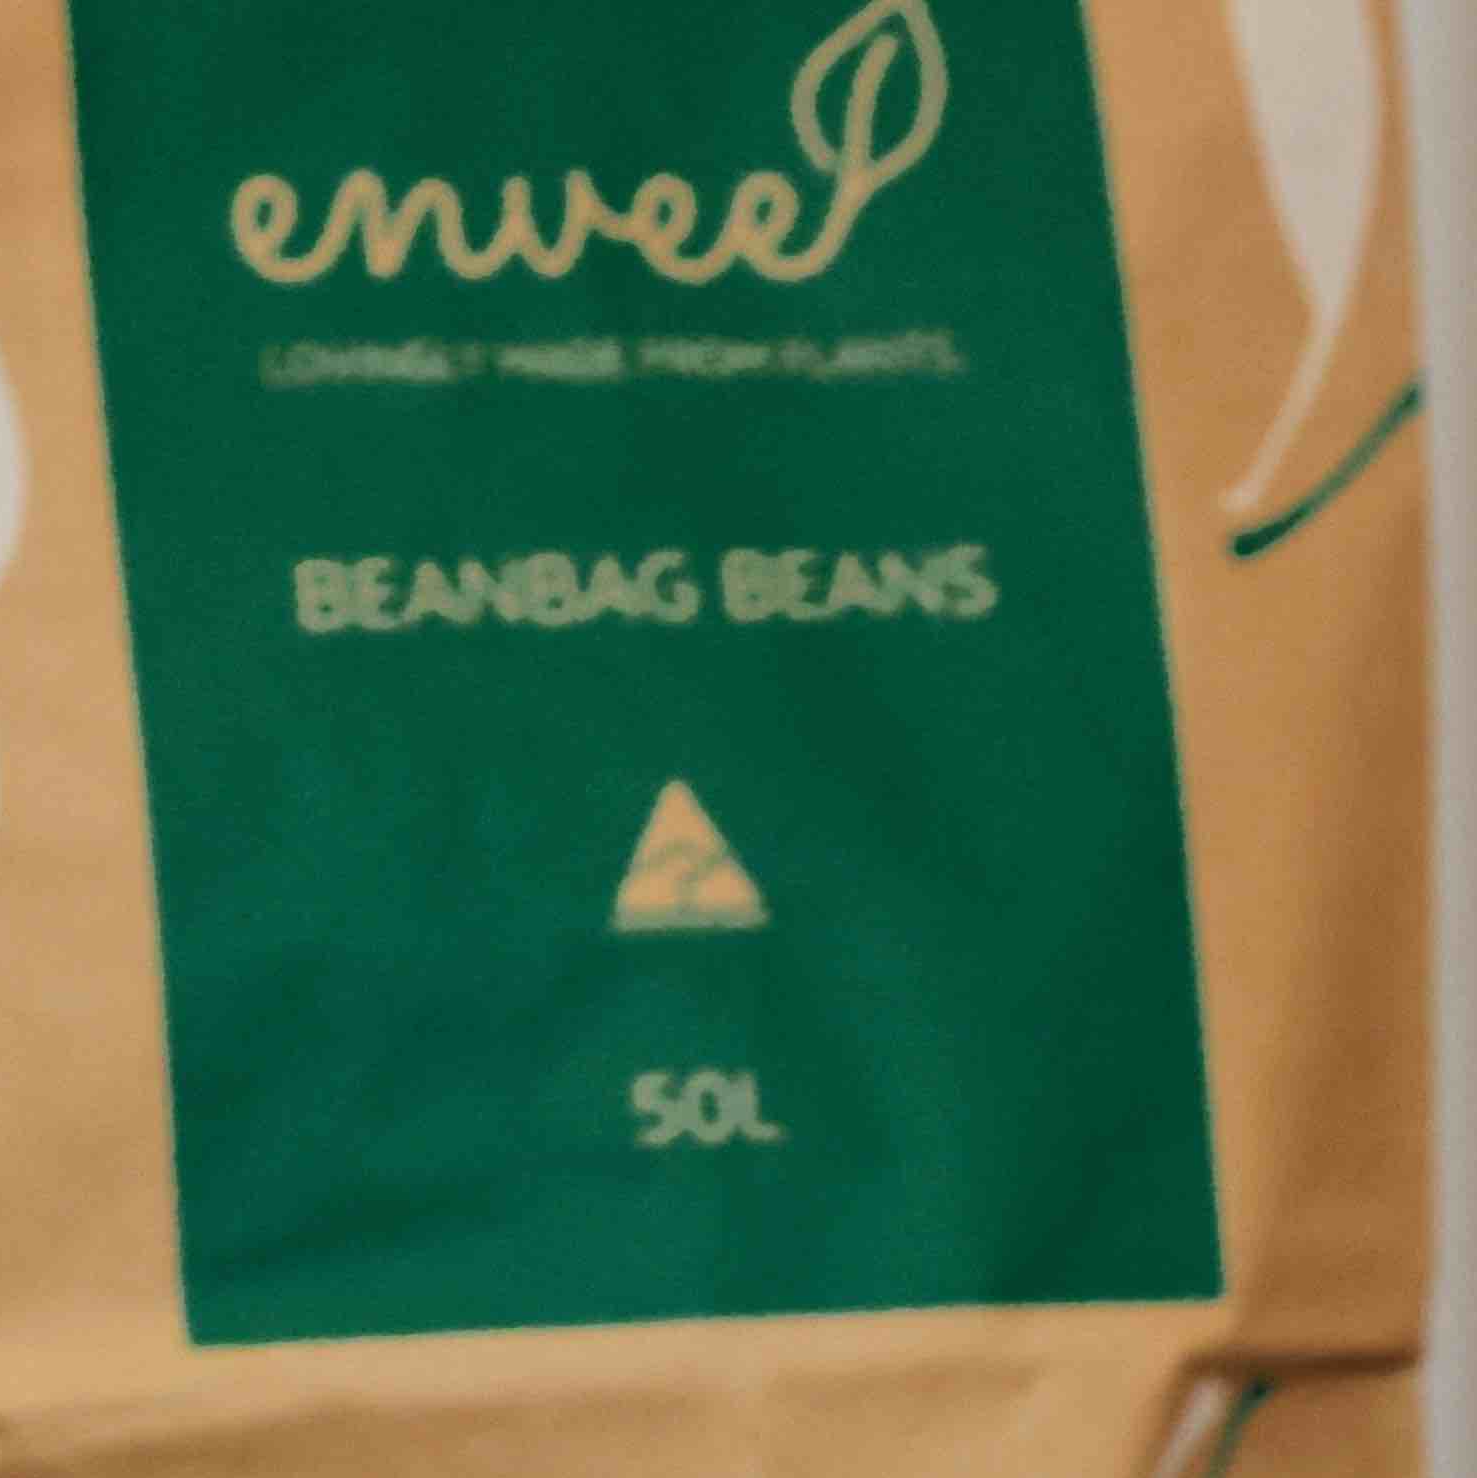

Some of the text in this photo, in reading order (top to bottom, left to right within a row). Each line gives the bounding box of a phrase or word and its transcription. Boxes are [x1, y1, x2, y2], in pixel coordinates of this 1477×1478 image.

[292, 542, 998, 633] BEANBAG BEANS
[629, 1068, 787, 1148] 50L
